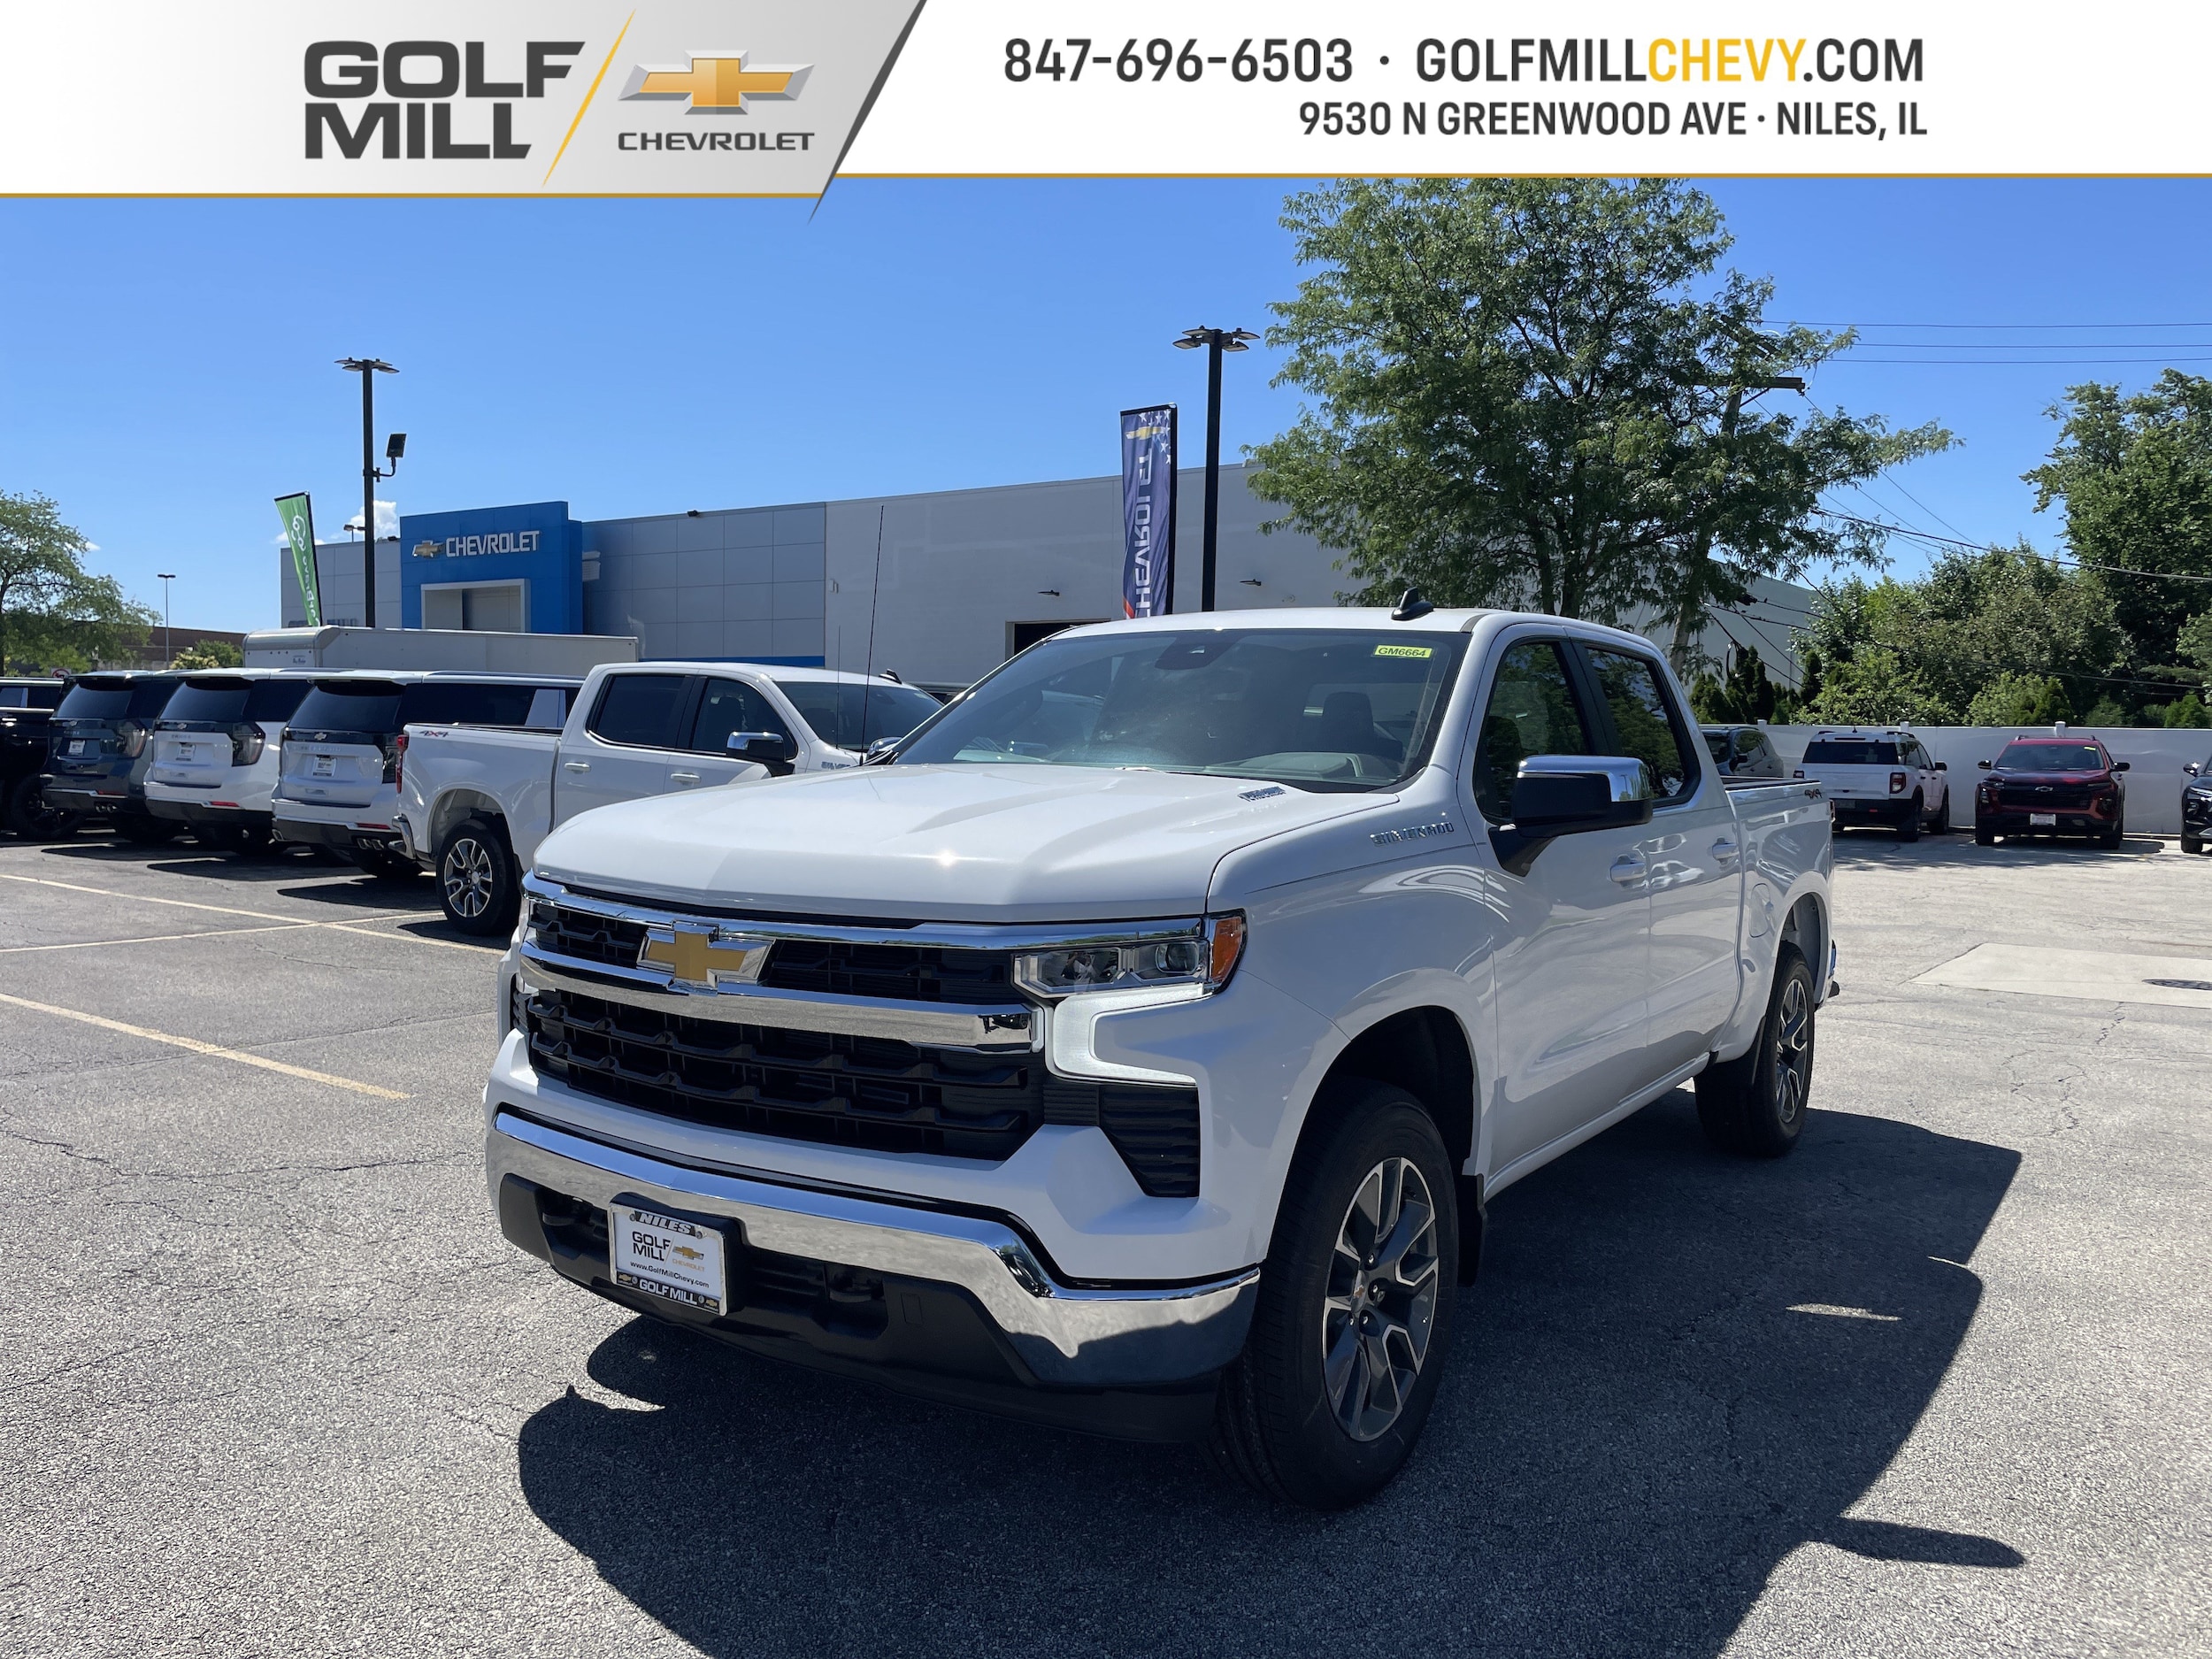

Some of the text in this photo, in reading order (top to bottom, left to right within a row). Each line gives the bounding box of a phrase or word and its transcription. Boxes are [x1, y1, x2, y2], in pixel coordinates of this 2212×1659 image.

[446, 531, 540, 557] CHEVROLET
[1379, 648, 1426, 657] GM6664
[640, 1213, 692, 1234] NILES
[632, 1231, 671, 1250] GOLF
[633, 1242, 665, 1262] MILL
[630, 1261, 710, 1288] www.GolfMillChevy.com
[672, 1258, 705, 1272] CHEVROLET
[639, 1279, 698, 1305] GOLF MILL
